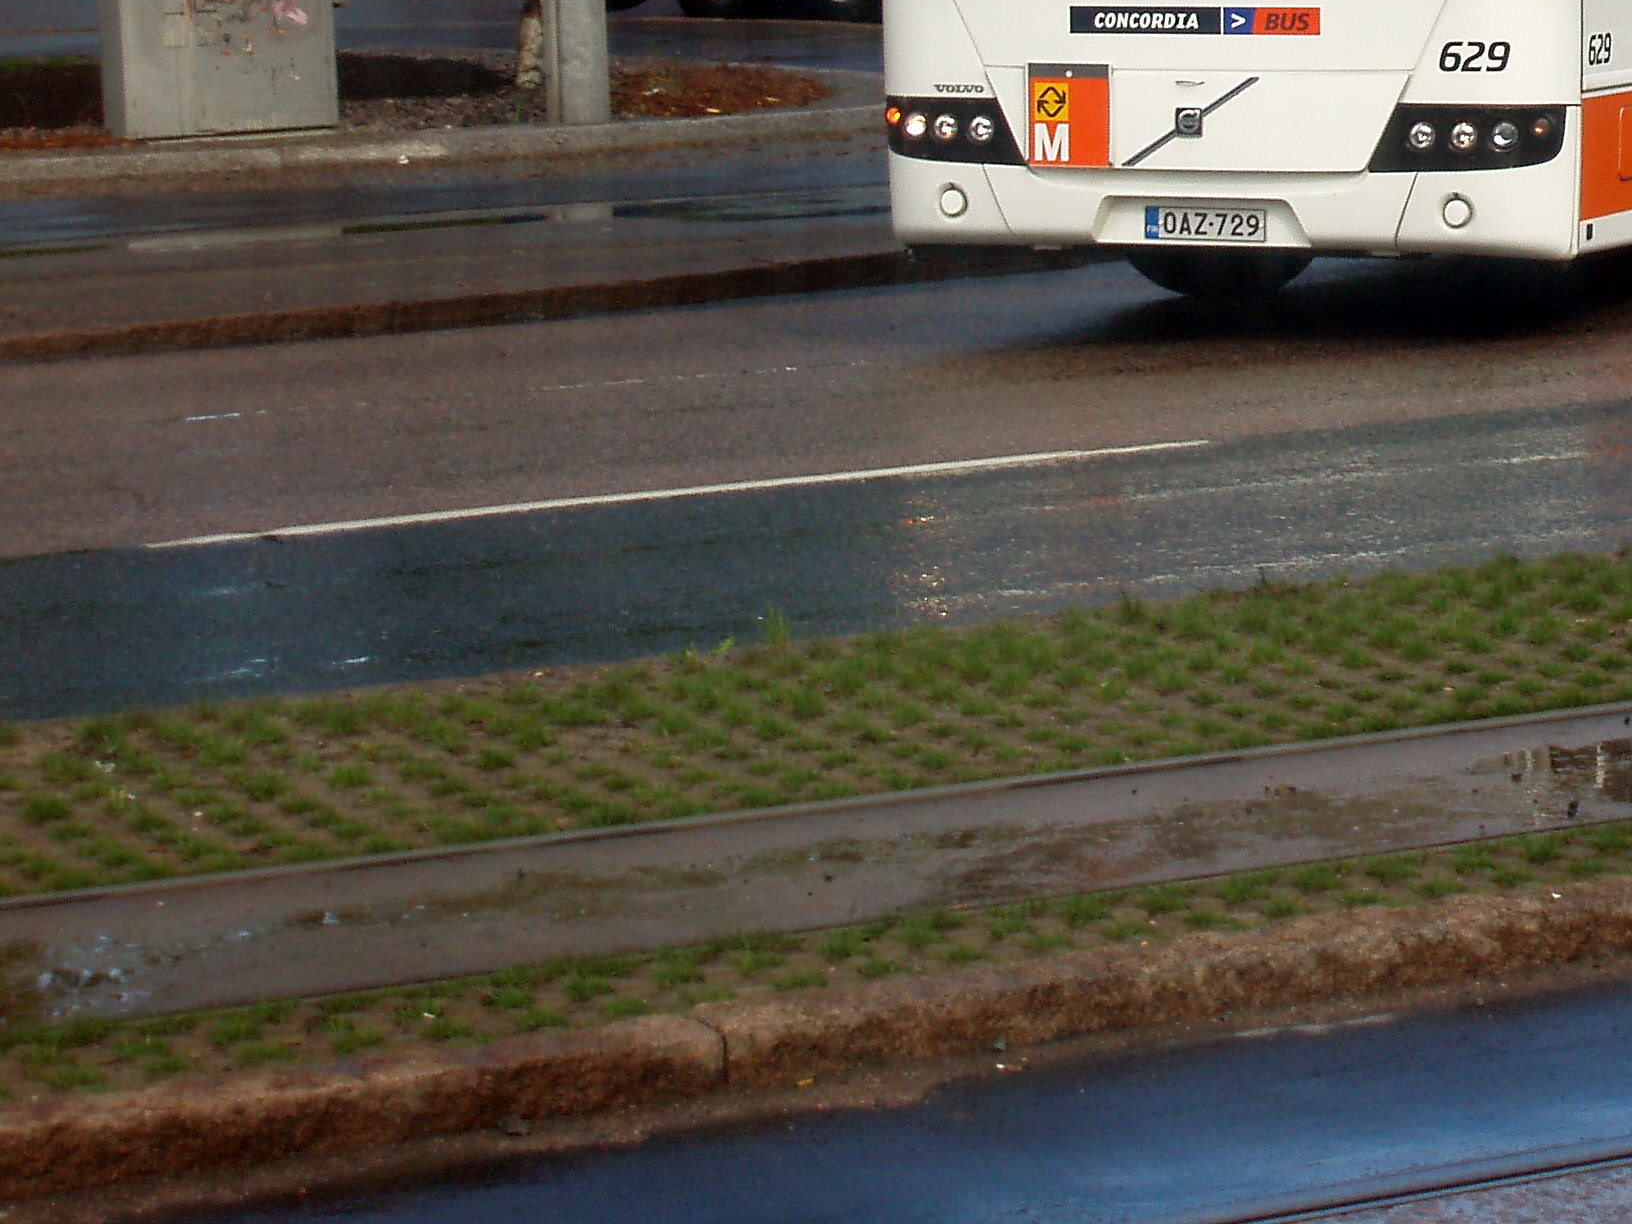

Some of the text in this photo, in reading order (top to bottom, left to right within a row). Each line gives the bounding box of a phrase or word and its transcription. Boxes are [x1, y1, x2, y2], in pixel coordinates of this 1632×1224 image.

[1093, 12, 1311, 31] CONCORDIA BUS
[1438, 40, 1511, 73] 629
[1588, 32, 1613, 66] 629
[933, 84, 985, 93] VOLVO
[1033, 122, 1070, 162] M
[1163, 210, 1261, 237] OAZ-729
